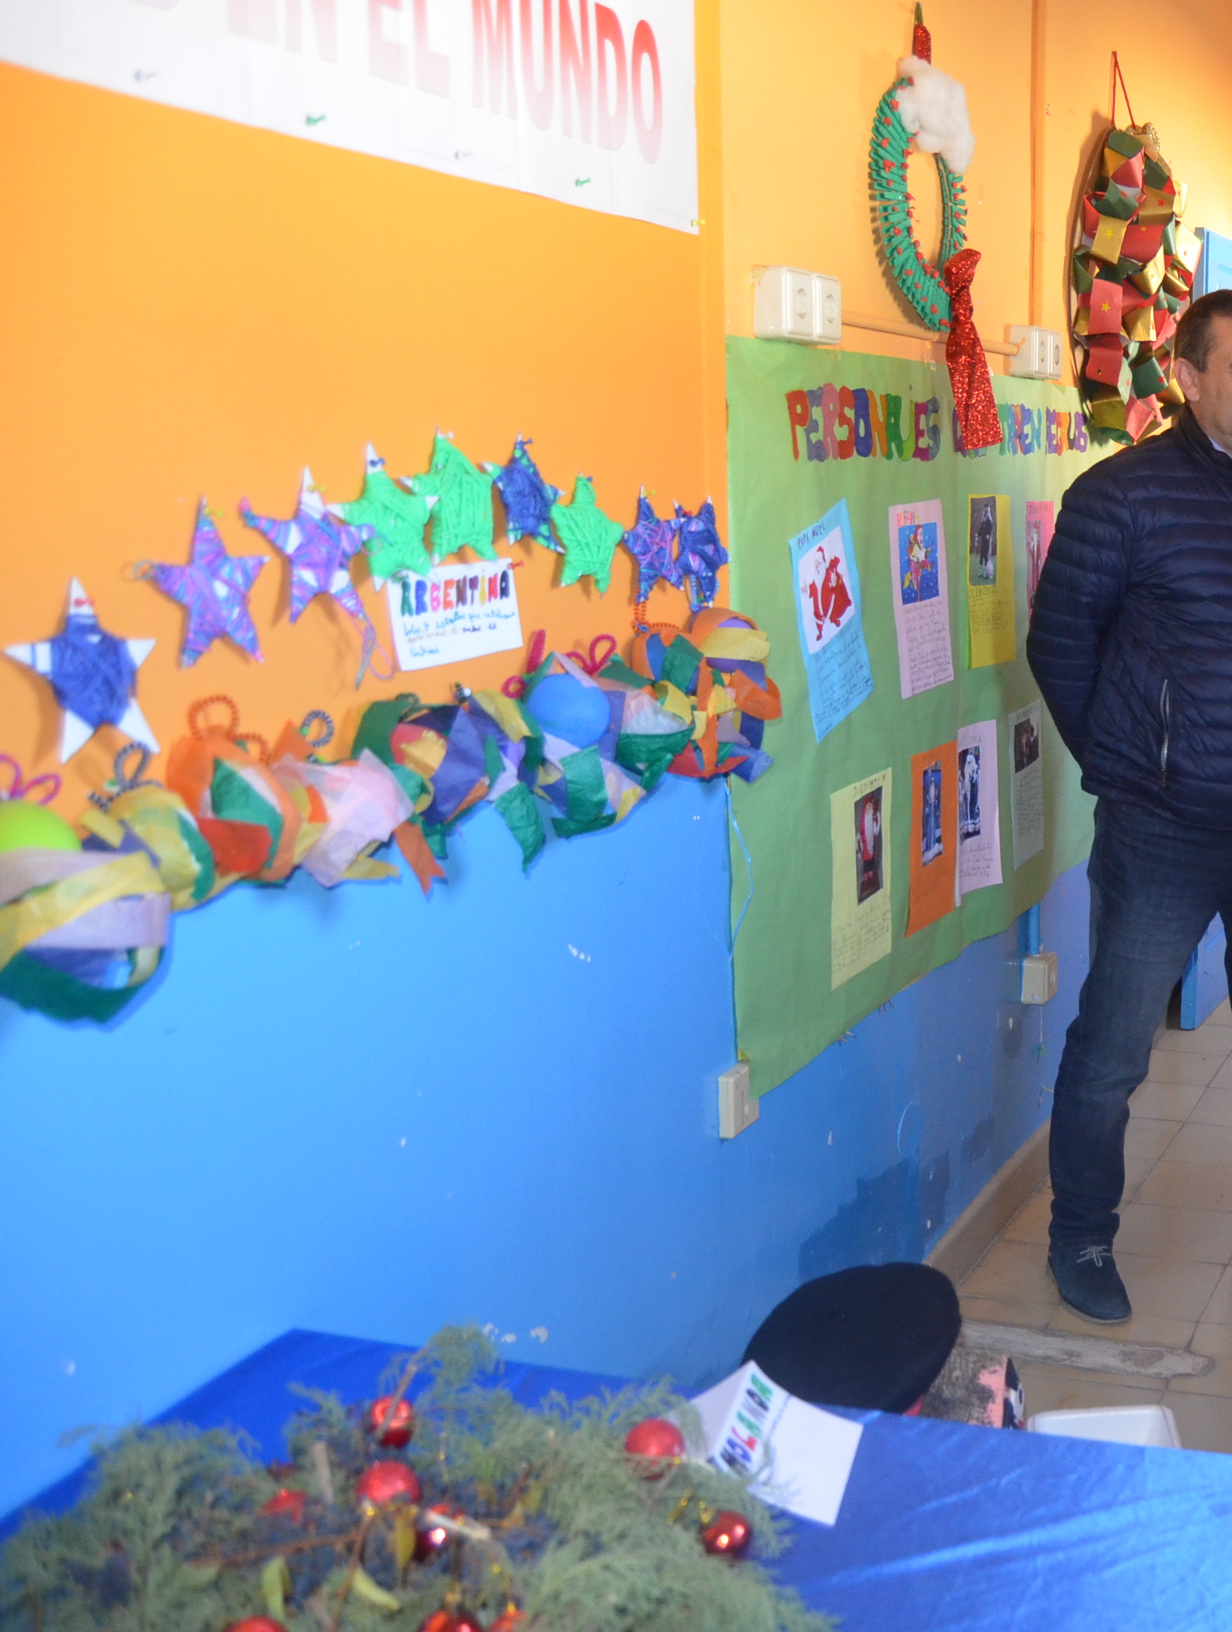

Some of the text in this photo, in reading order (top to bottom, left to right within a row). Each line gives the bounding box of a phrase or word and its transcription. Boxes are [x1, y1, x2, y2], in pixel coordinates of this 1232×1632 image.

[471, 0, 663, 164] MUNDO
[785, 382, 941, 462] PERSONAJES
[401, 570, 509, 616] ARGENTINA
